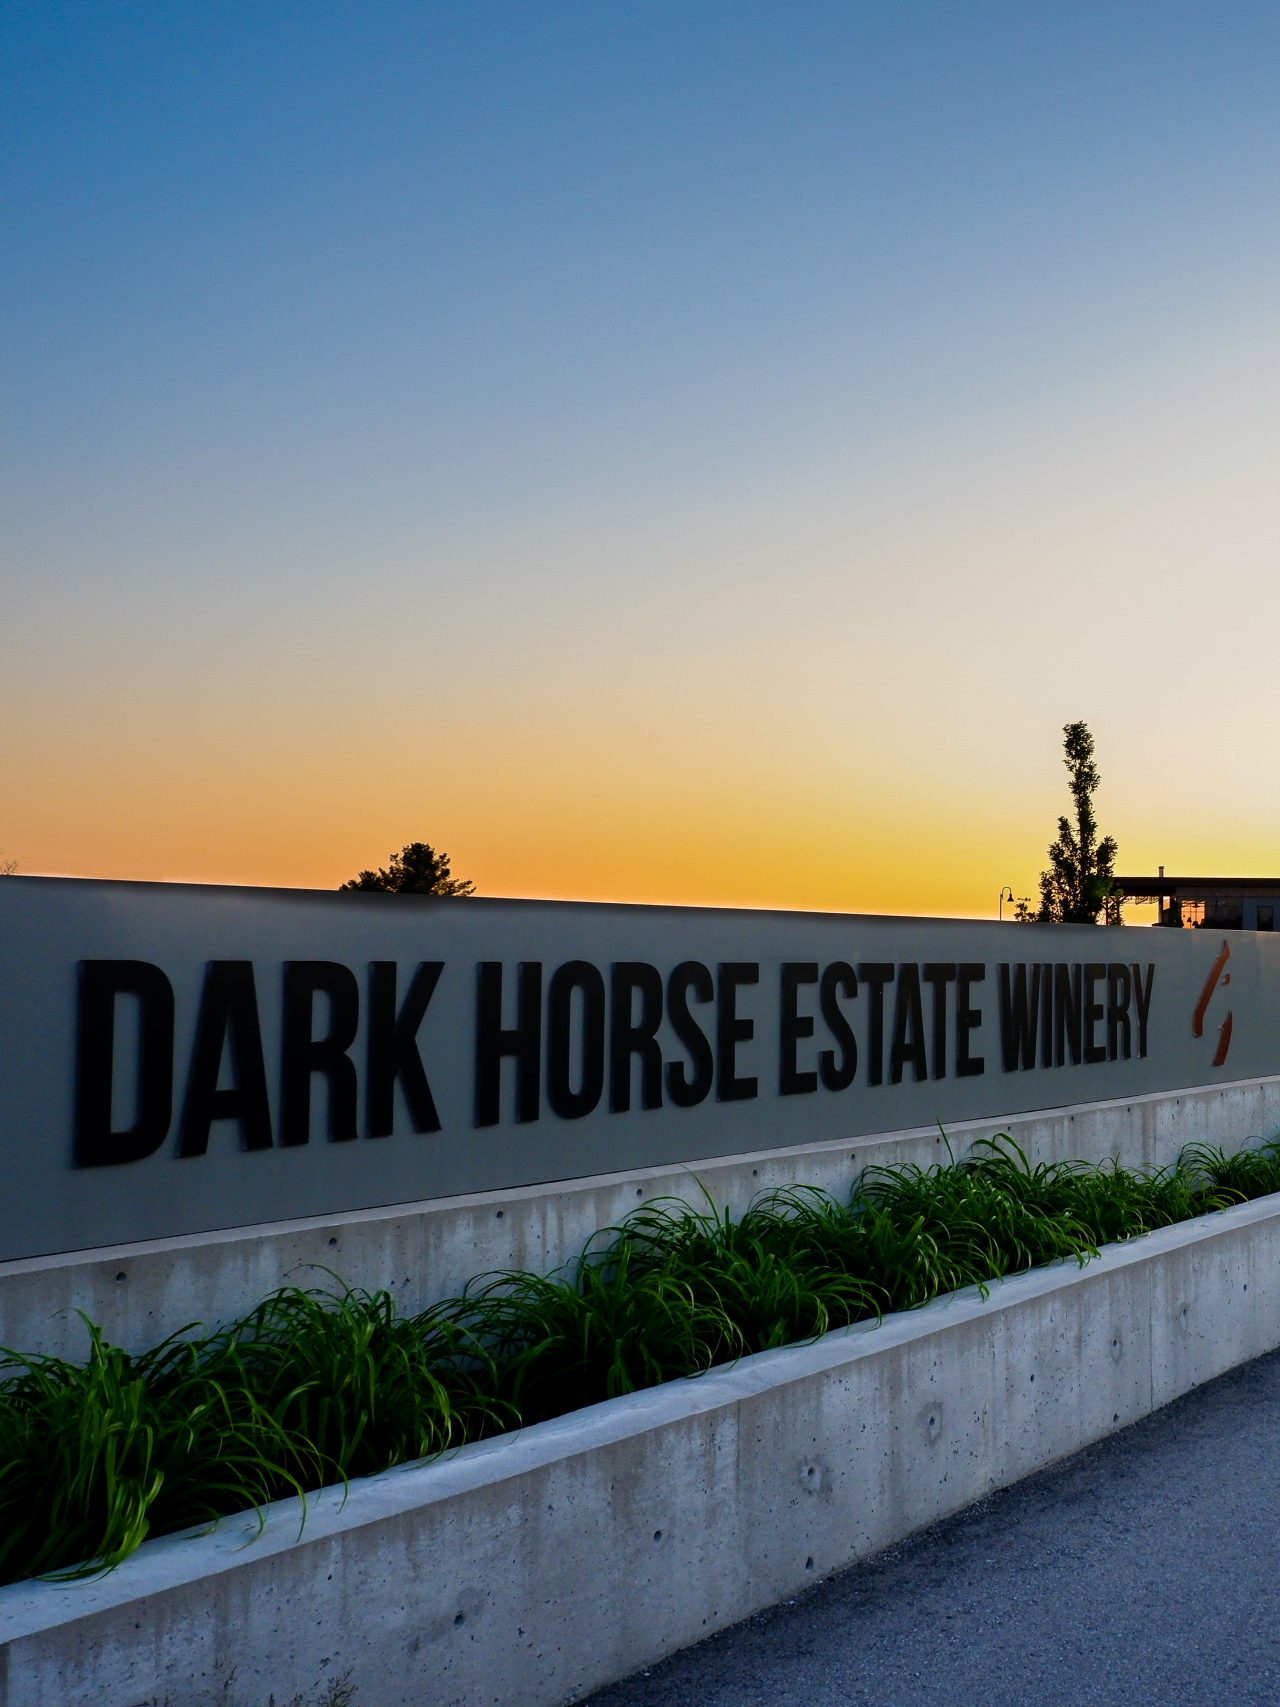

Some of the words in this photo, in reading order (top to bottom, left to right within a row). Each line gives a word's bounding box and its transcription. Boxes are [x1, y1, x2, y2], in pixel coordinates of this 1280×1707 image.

[74, 959, 446, 1169] DARK
[474, 960, 760, 1128] HORSE
[779, 961, 986, 1096] ESTATE
[997, 962, 1155, 1073] WINERY
